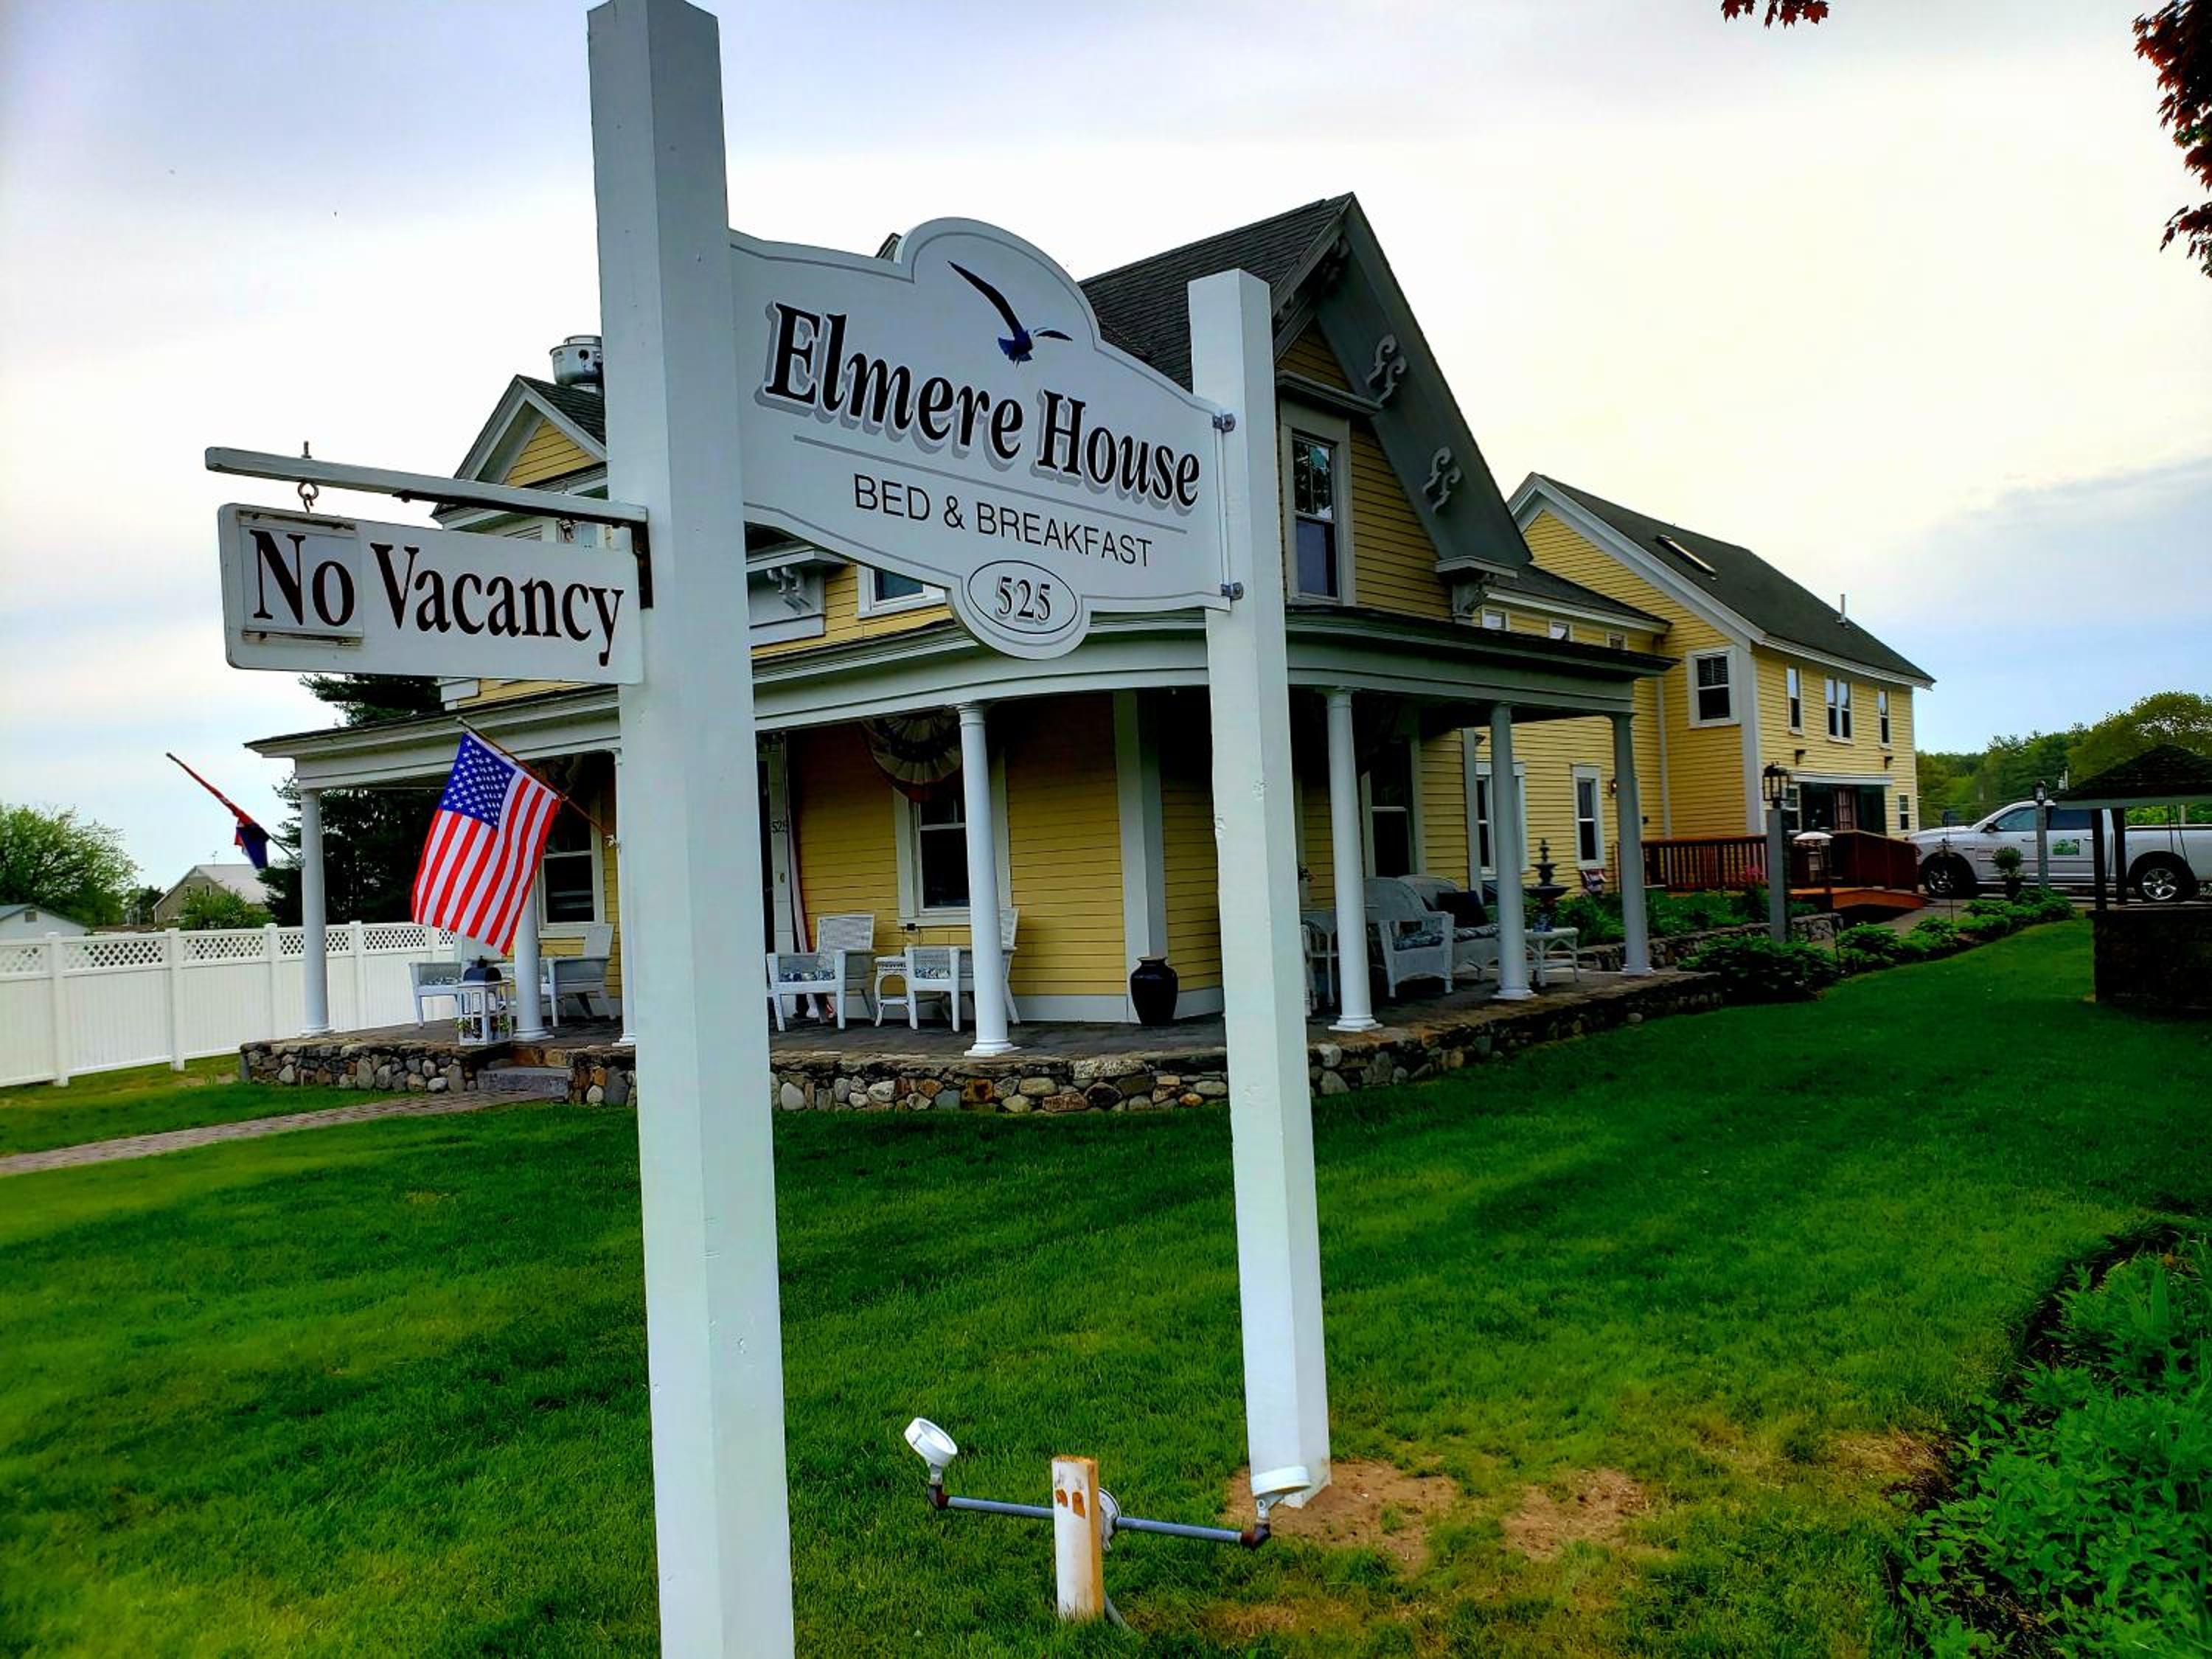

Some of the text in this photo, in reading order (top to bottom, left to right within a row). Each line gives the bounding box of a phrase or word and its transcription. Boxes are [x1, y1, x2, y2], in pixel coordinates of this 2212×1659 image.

[762, 302, 1200, 507] Elmere House
[853, 473, 1152, 567] BED & BREAKFAST
[248, 529, 625, 667] No Vacancy
[997, 575, 1051, 621] 525
